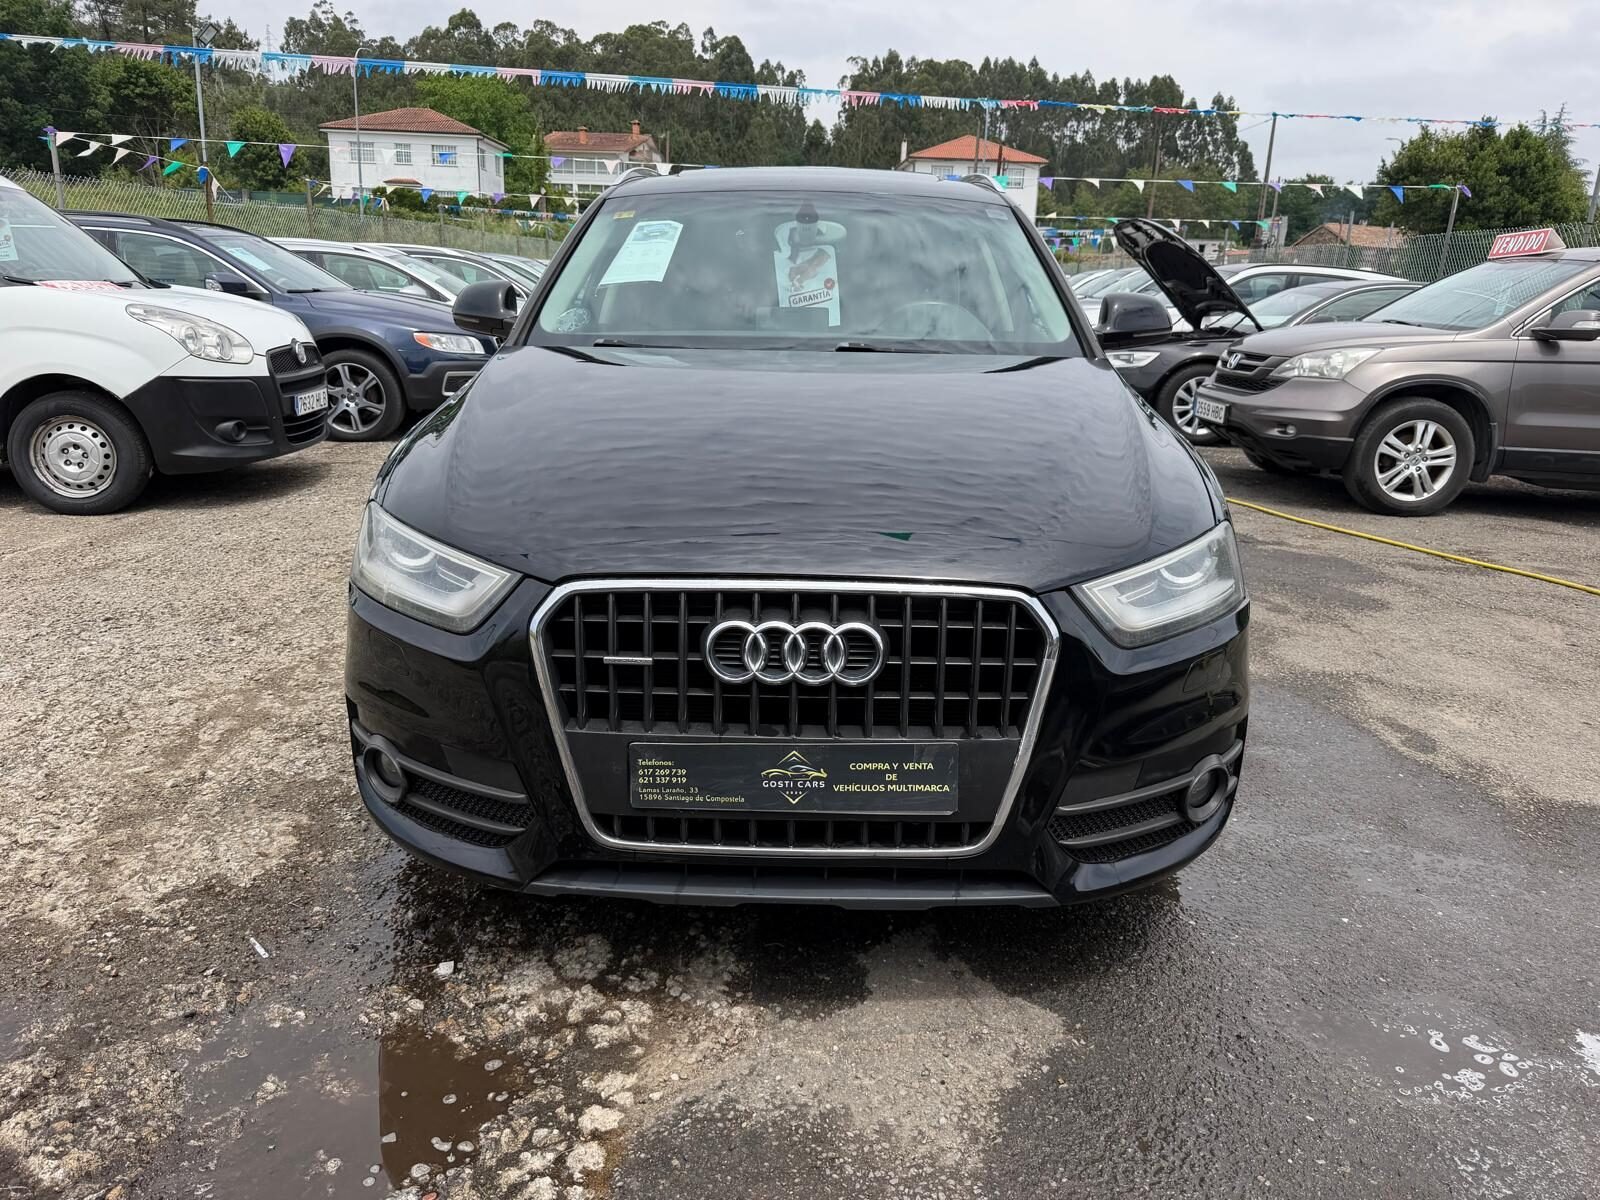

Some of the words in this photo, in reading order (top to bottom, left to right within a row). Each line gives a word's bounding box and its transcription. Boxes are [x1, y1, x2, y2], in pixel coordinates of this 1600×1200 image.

[1493, 232, 1545, 254] VENDIDO
[792, 290, 831, 305] GARANTÍA
[299, 393, 315, 414] 7632
[1196, 400, 1211, 417] 2559
[849, 762, 890, 771] COMPRA
[892, 762, 899, 770] Y
[902, 762, 934, 770] VENTA
[638, 768, 653, 776] 617
[655, 768, 670, 776] 269
[671, 768, 687, 776] 739
[885, 773, 898, 781] DE
[638, 776, 653, 784] 621
[655, 776, 669, 784] 337
[671, 776, 687, 784] 919
[762, 780, 793, 788] GOSTI
[797, 780, 826, 788] CARS
[832, 782, 886, 792] VEHÍCULOS
[887, 784, 950, 793] MULTIMARCA
[664, 794, 694, 803] Santiago
[705, 795, 745, 804] Compostela
